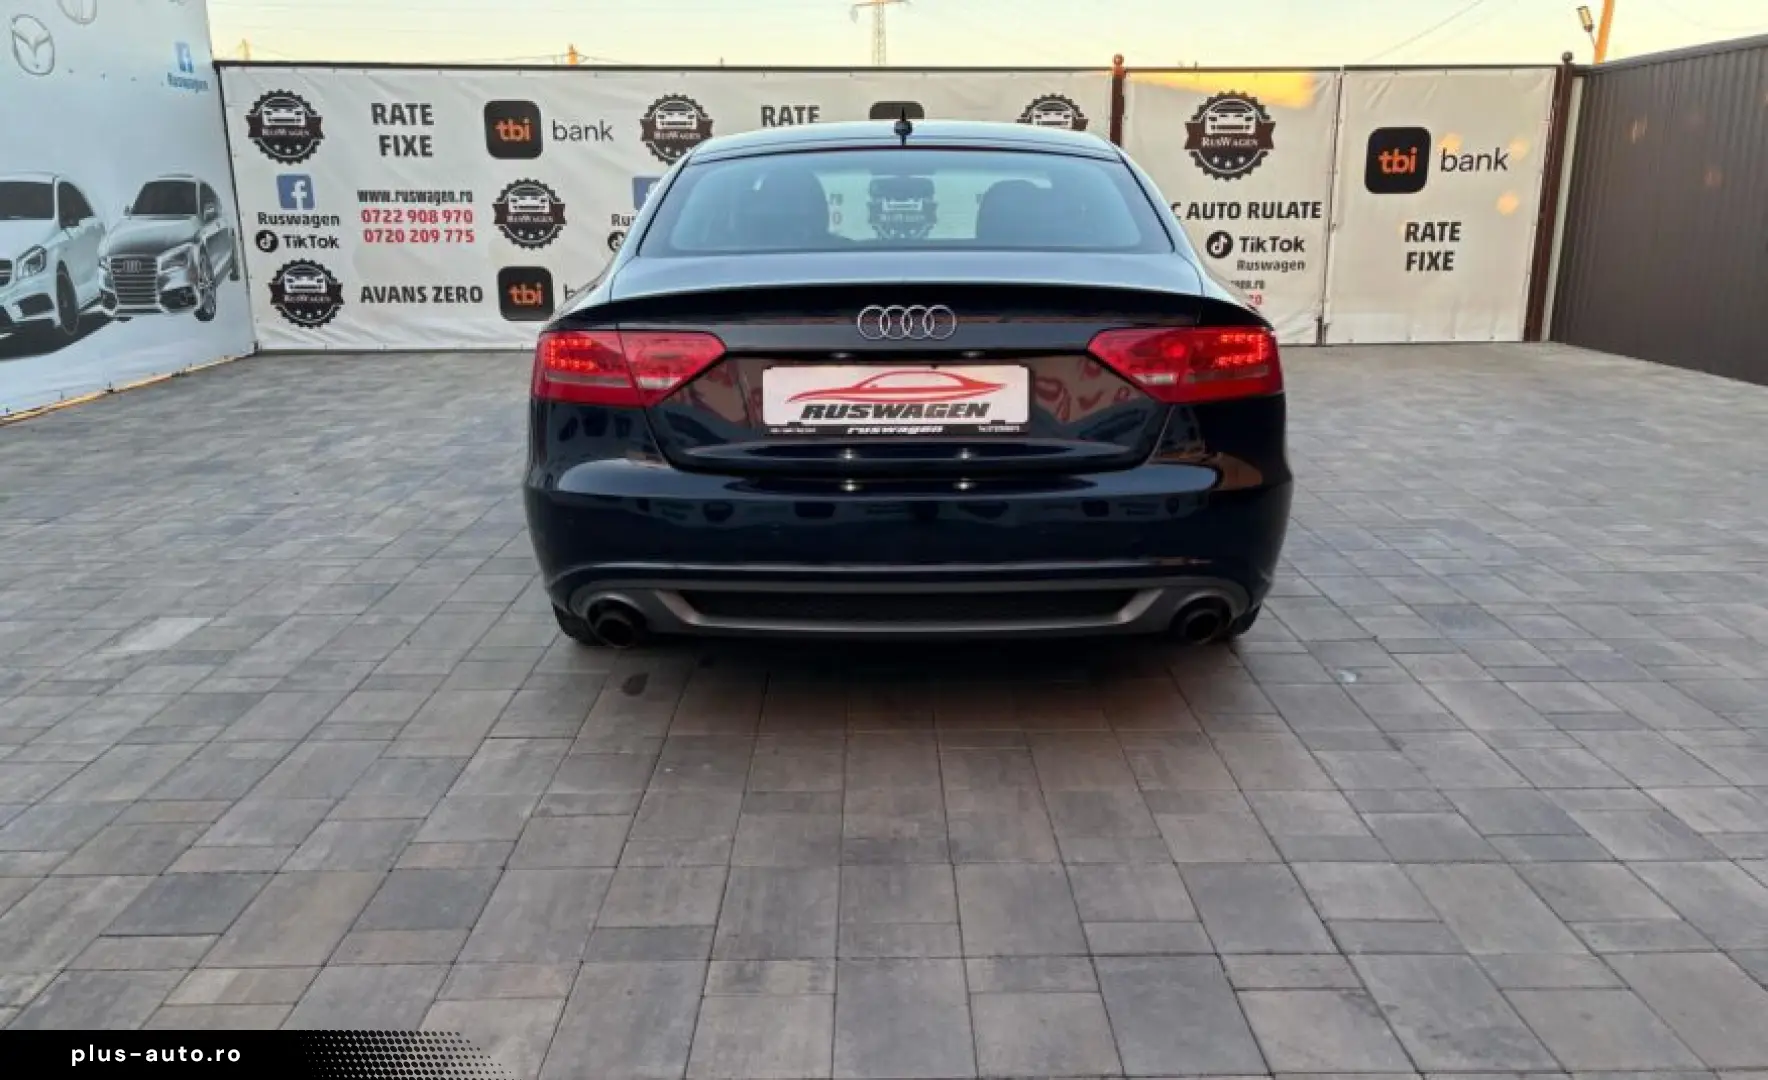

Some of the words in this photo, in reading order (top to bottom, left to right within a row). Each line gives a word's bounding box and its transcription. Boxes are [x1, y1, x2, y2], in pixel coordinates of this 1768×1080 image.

[371, 103, 434, 126] RATE
[761, 105, 820, 127] RATE
[495, 119, 531, 141] tbi
[552, 119, 614, 141] bank
[379, 135, 433, 157] FIXE
[1378, 147, 1418, 174] tbi
[1440, 147, 1509, 172] bank
[357, 190, 473, 206] www.ruswagen.ro
[361, 209, 403, 224] 0722
[407, 209, 439, 224] 908
[442, 209, 473, 224] 970
[1186, 202, 1242, 220] AUTO
[1247, 202, 1322, 219] RULATE
[257, 212, 340, 228] Ruswagen
[363, 229, 404, 243] 0720
[409, 229, 439, 243] 209
[443, 229, 475, 243] 775
[1404, 222, 1462, 242] RATE
[283, 235, 340, 250] TikTok
[1239, 236, 1305, 252] TikTok
[1237, 260, 1306, 273] Ruswagen
[1405, 251, 1455, 271] FIXE
[360, 286, 427, 303] AVANS
[433, 286, 483, 303] ZERO
[508, 282, 543, 305] tbi
[800, 402, 990, 419] RUSWAGEN
